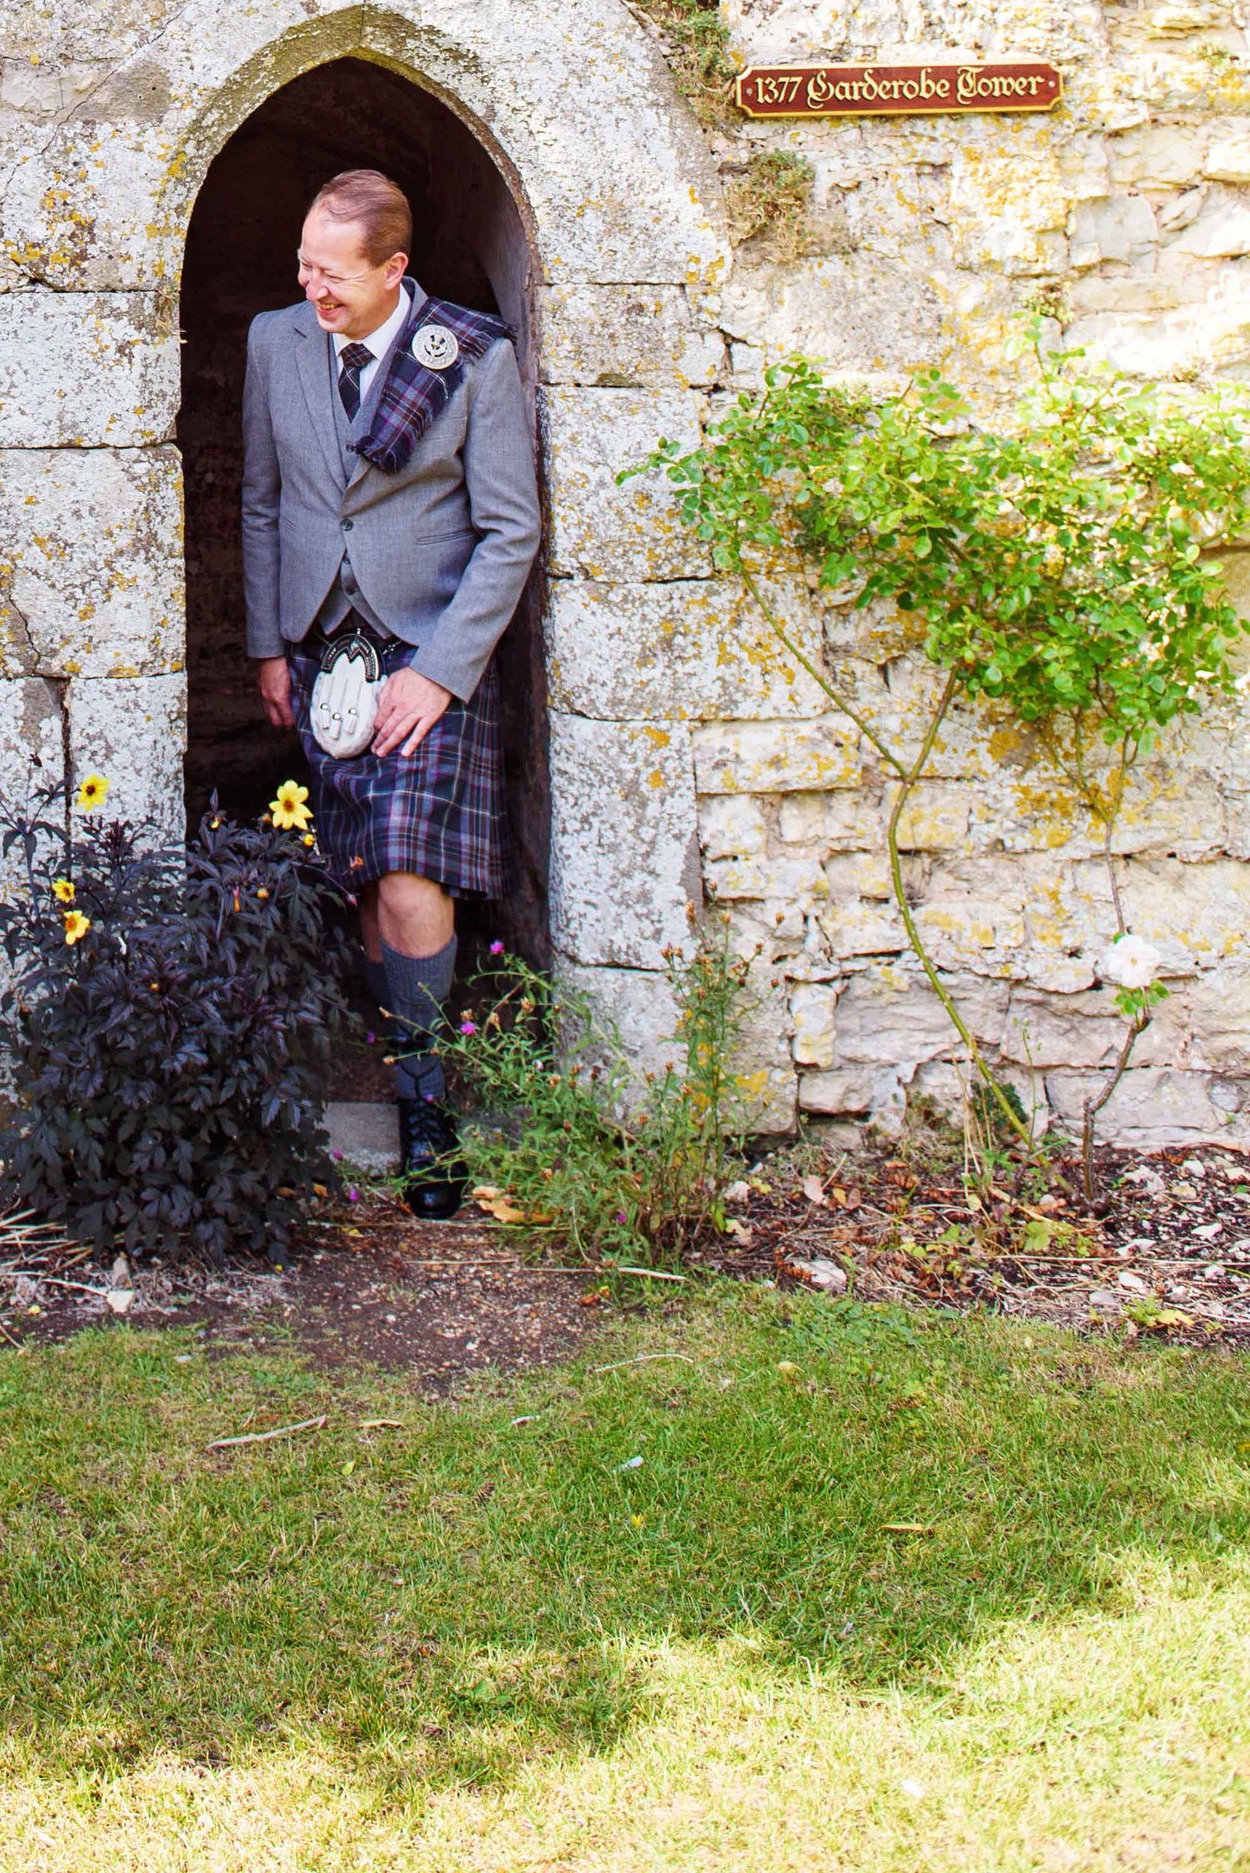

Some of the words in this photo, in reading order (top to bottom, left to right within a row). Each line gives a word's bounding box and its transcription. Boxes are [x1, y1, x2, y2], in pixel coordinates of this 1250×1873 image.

[754, 76, 803, 104] 1377
[807, 68, 950, 109] Garderobe
[957, 66, 1045, 105] Tower
